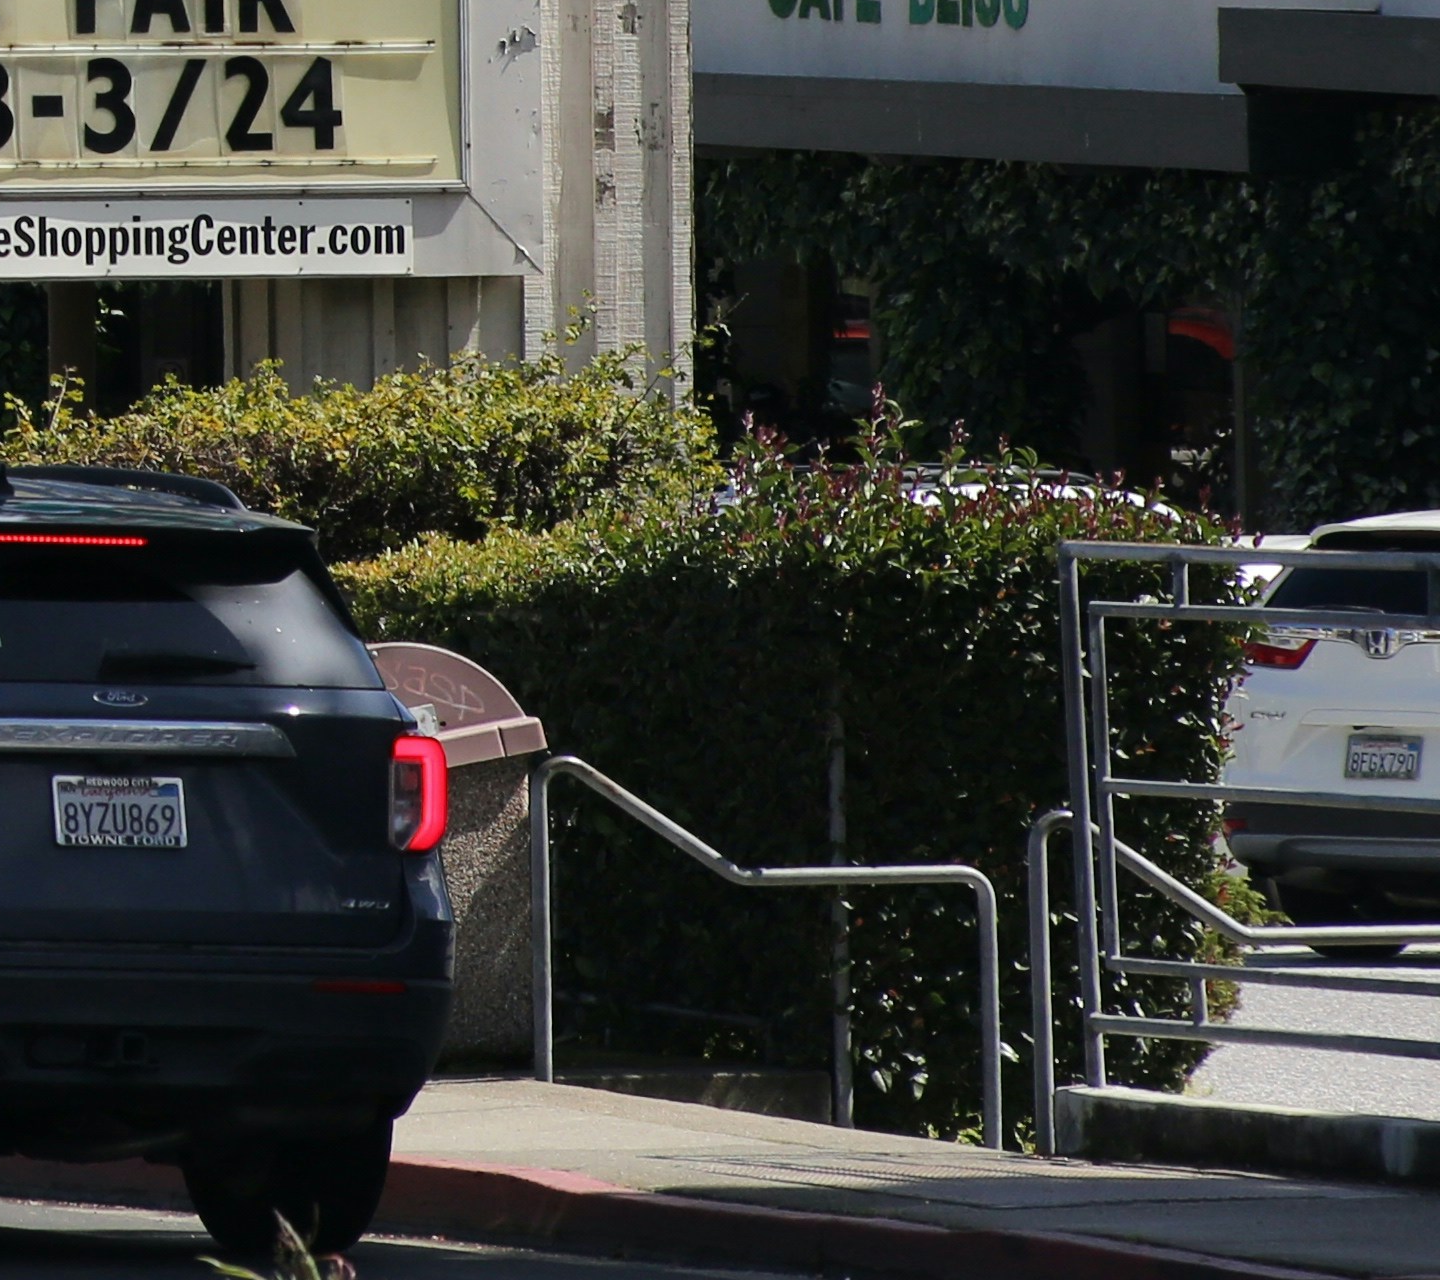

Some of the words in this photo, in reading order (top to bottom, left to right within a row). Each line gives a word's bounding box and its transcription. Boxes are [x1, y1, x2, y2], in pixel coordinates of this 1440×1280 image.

[107, 691, 136, 703] Ford
[14, 729, 238, 748] EXPLORER
[1350, 751, 1416, 774] 8FGX790
[86, 777, 130, 787] REDWOOD
[132, 778, 150, 787] CITY
[64, 802, 175, 836] 8YZU869
[70, 834, 126, 846] TOWNE
[134, 835, 175, 846] FORD
